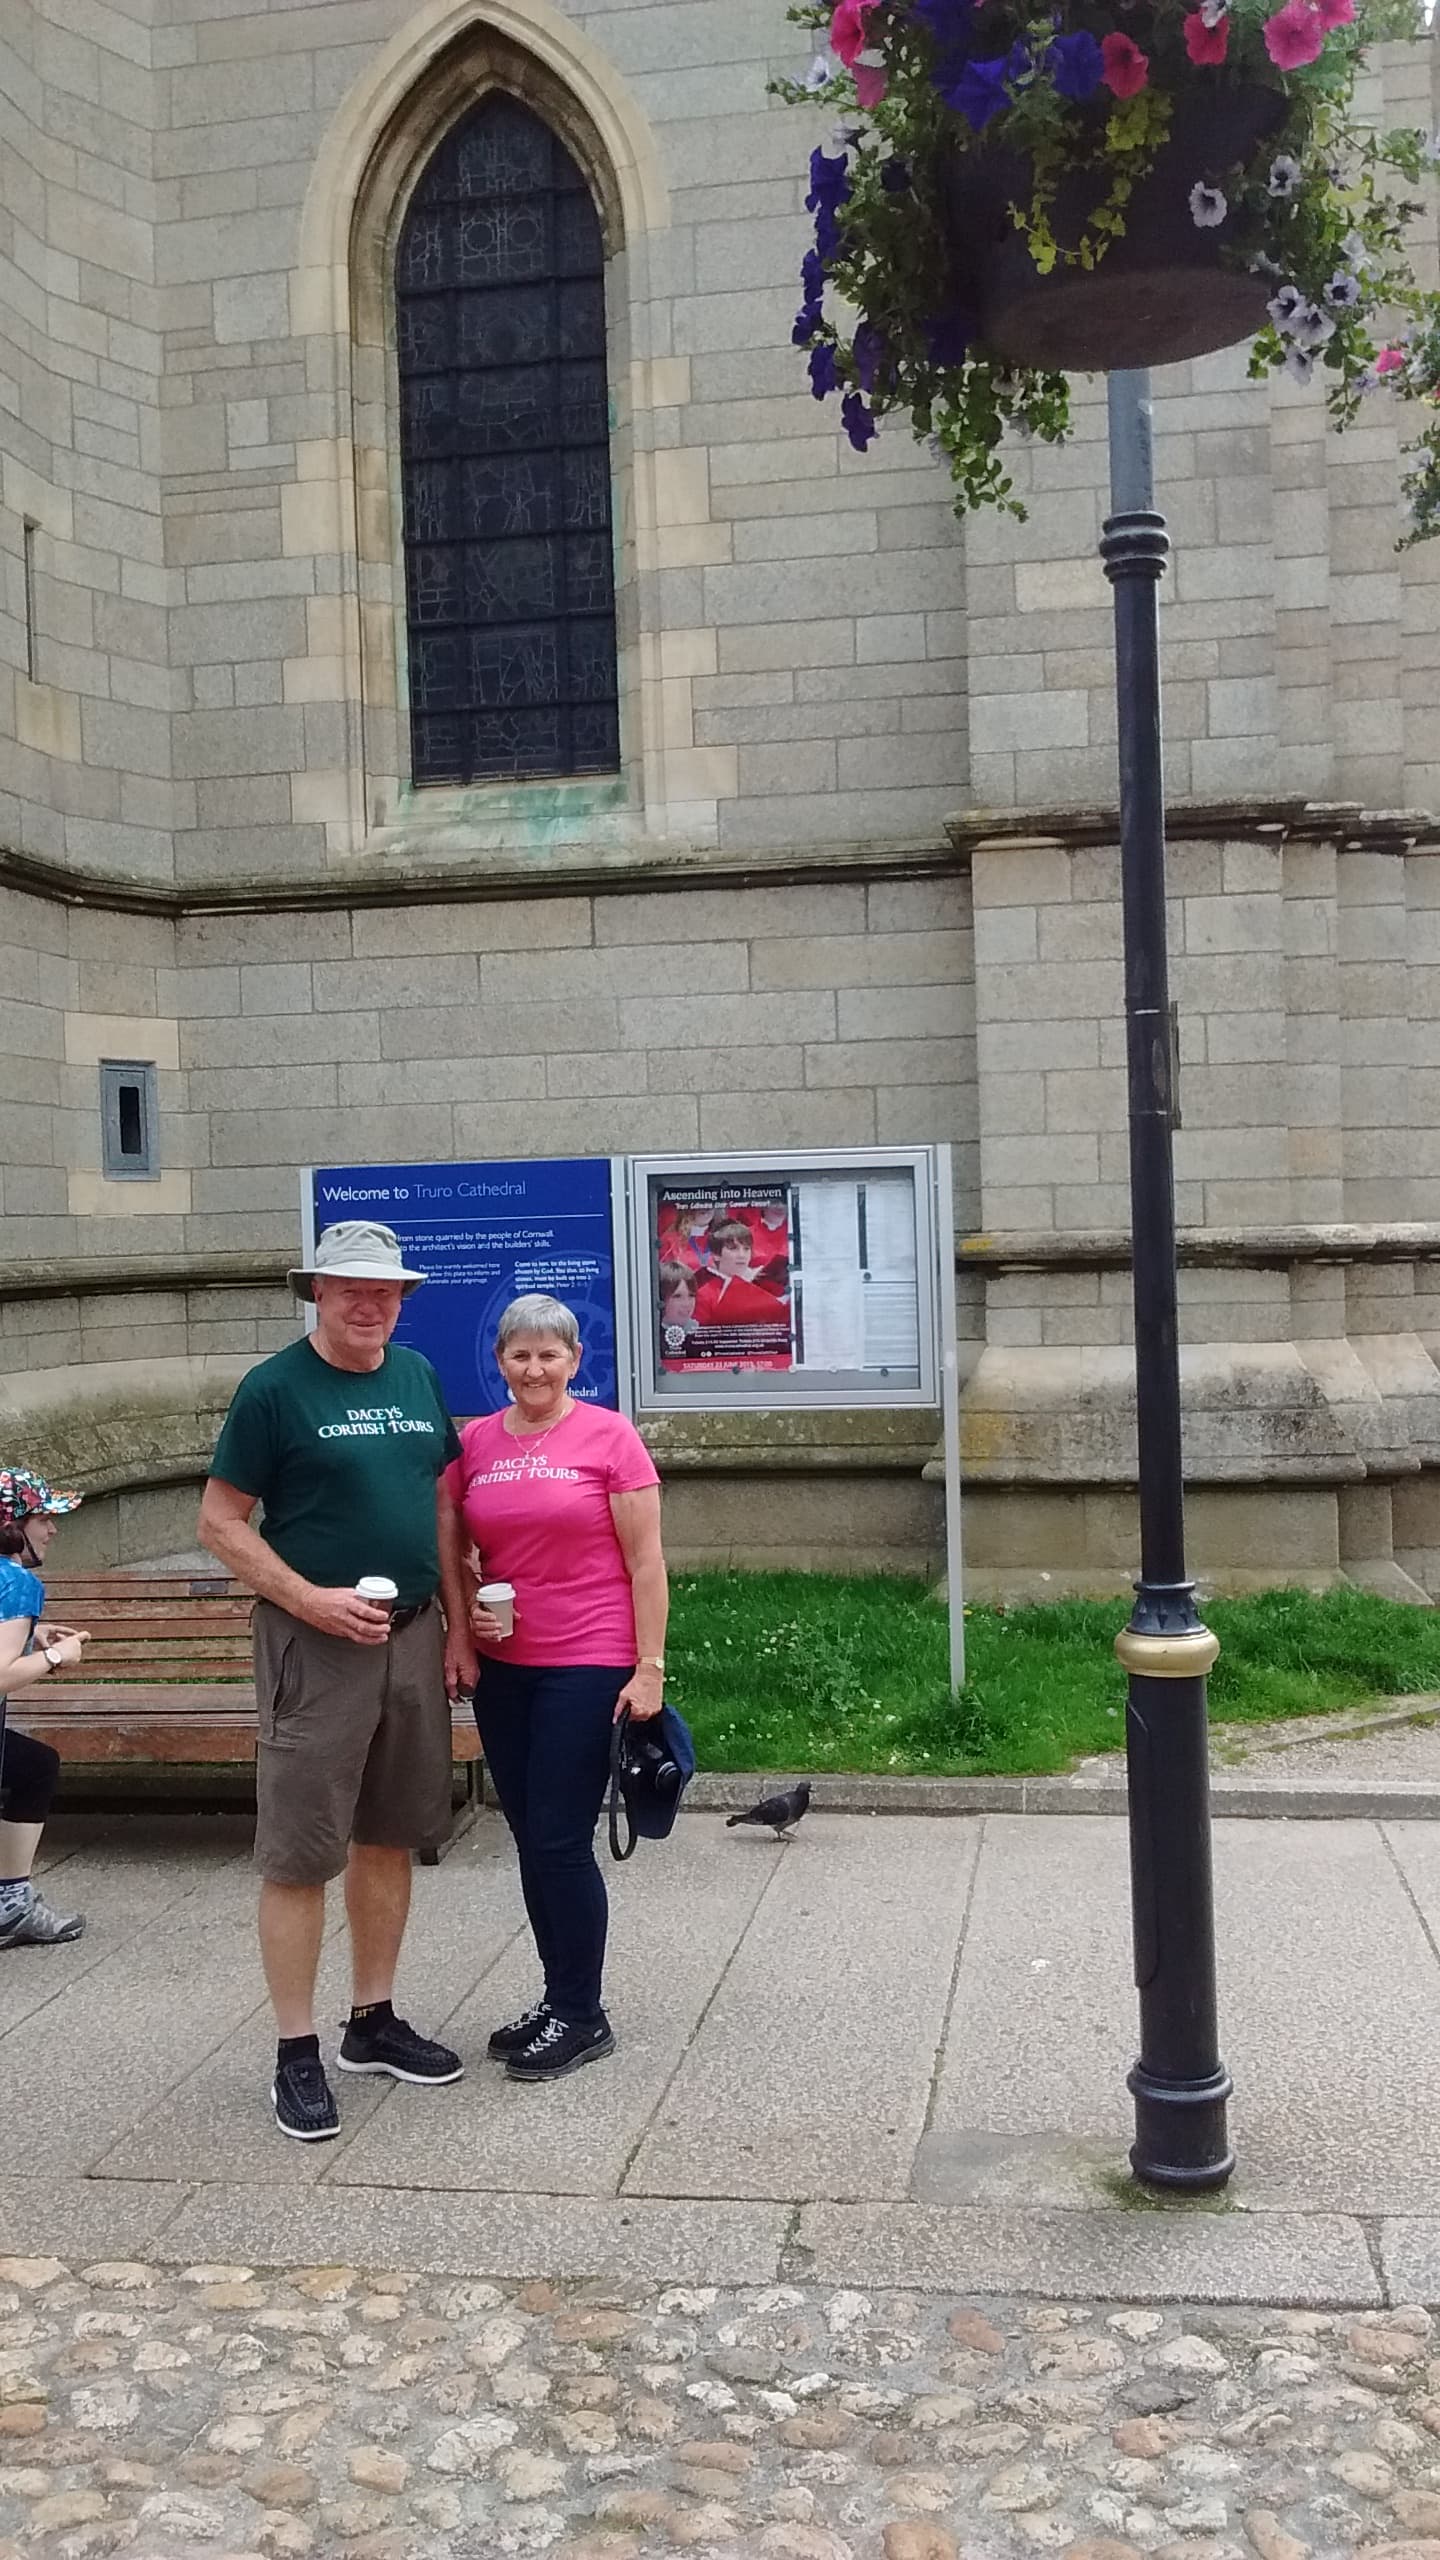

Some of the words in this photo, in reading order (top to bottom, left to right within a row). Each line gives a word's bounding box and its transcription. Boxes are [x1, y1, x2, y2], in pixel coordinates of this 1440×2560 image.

[322, 1186, 390, 1202] Welcome
[392, 1186, 409, 1200] to
[413, 1184, 453, 1199] Truro
[457, 1180, 526, 1198] Cathedral
[663, 1189, 718, 1200] Ascending
[720, 1189, 740, 1198] into
[743, 1188, 782, 1198] Heaven
[414, 1233, 434, 1242] stone
[435, 1232, 464, 1242] quarried
[465, 1231, 474, 1241] by
[476, 1231, 487, 1240] the
[488, 1230, 512, 1241] people
[513, 1230, 522, 1239] of
[408, 1244, 420, 1252] the
[422, 1242, 456, 1252] architect's
[456, 1242, 476, 1250] vision
[478, 1242, 490, 1250] and
[682, 1362, 714, 1370] SATURDAY
[566, 1386, 598, 1397] hedral
[346, 1405, 404, 1422] DACEY'S
[318, 1422, 385, 1439] CORNISH
[387, 1418, 434, 1435] TOURS
[491, 1453, 549, 1472] DACEY'S
[527, 1467, 579, 1480] TOURS
